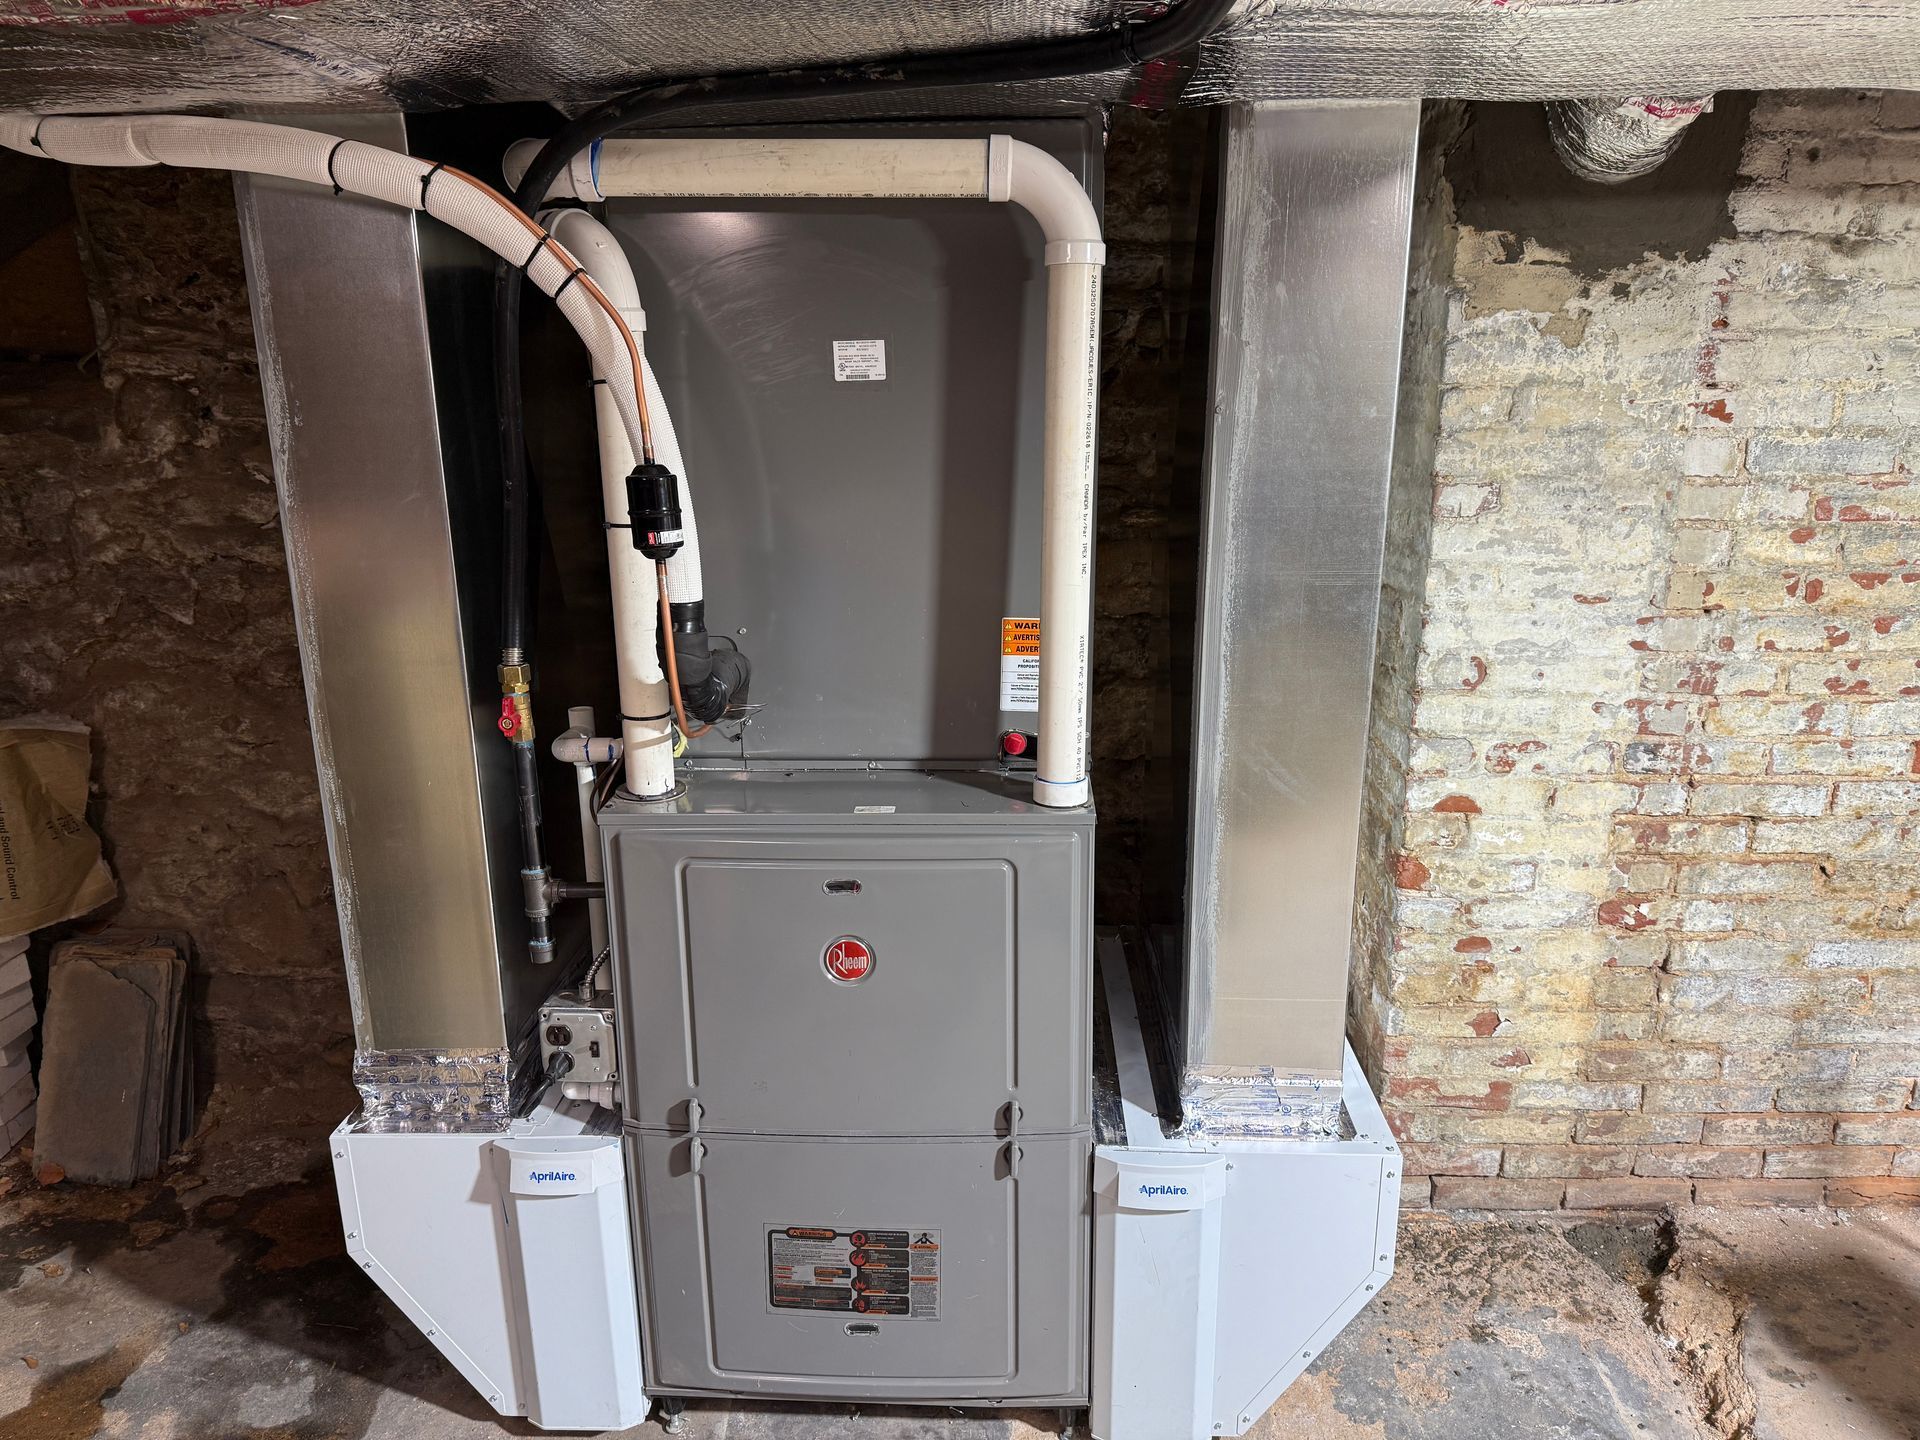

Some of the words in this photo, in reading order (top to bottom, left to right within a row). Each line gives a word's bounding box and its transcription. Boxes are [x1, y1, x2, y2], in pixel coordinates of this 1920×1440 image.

[1014, 622, 1040, 630] WAR
[1, 836, 15, 865] Sound
[6, 867, 21, 900] Control
[832, 943, 867, 974] Rheem
